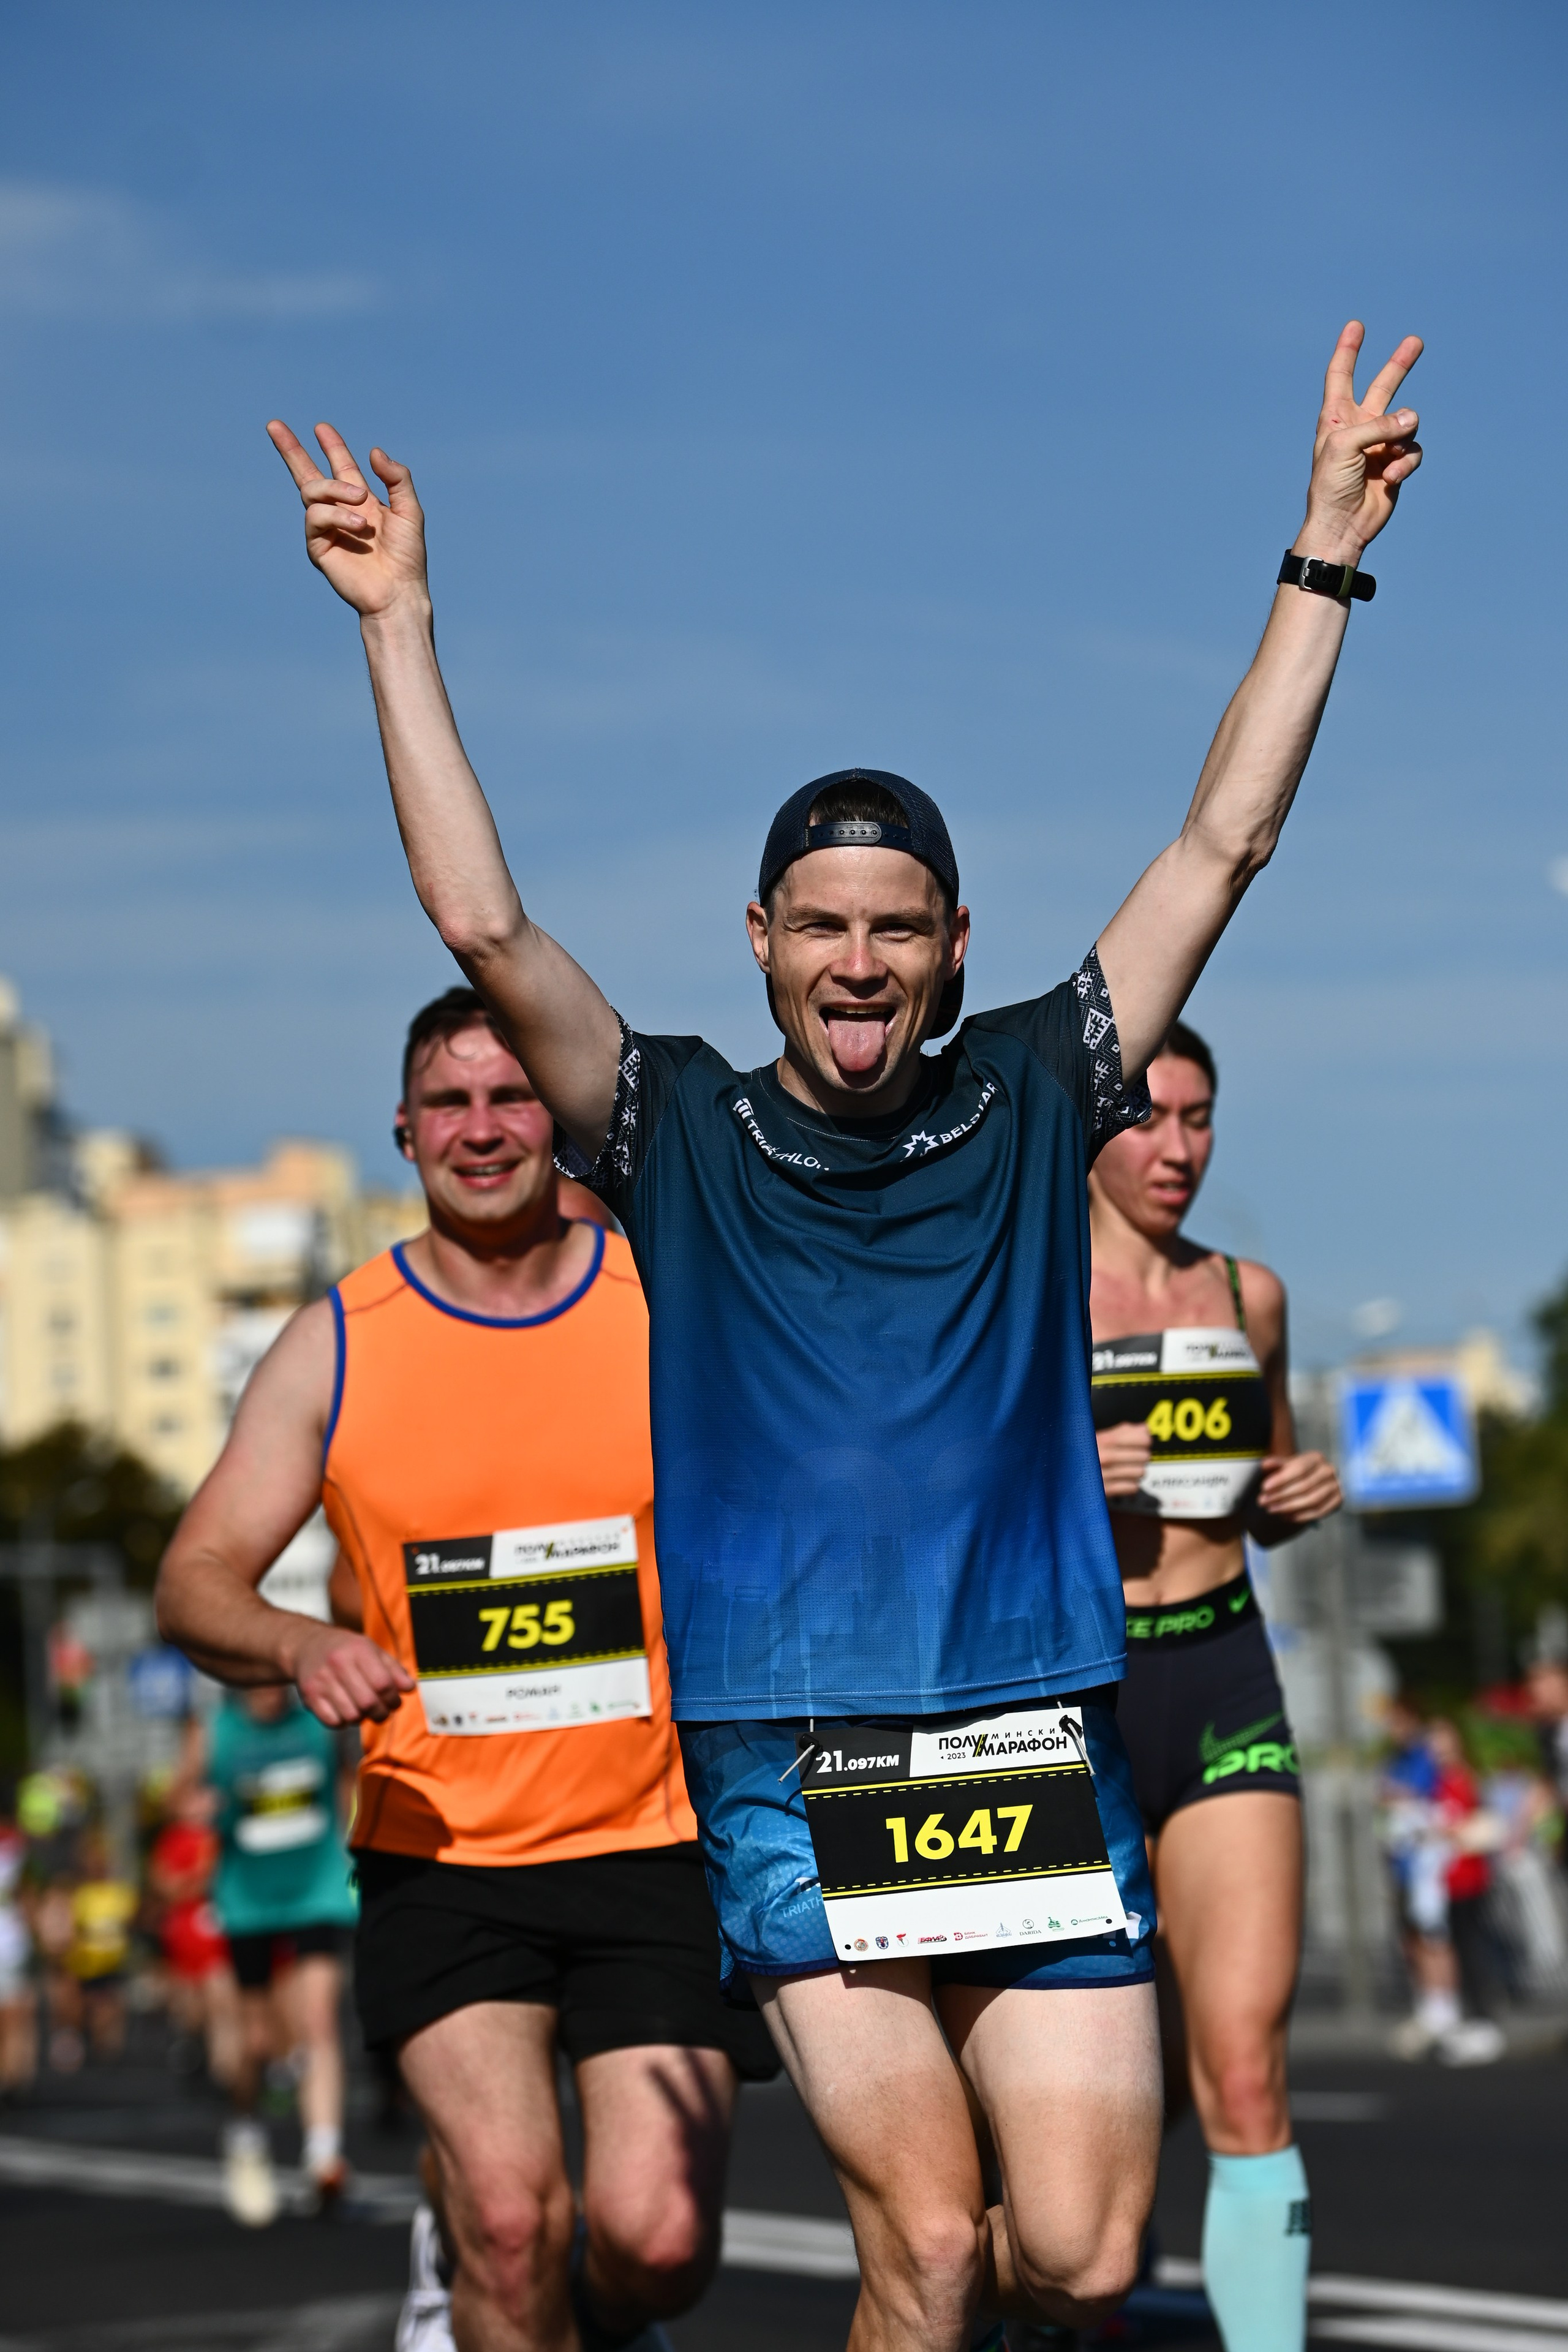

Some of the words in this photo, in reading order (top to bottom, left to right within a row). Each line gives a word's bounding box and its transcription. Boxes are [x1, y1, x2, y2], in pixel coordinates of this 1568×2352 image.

[1147, 1396, 1232, 1442] 406
[478, 1599, 575, 1652] 755
[1154, 1605, 1215, 1638] PRO
[991, 1727, 1066, 1740] МИНСКИ
[885, 1804, 1033, 1863] 1647
